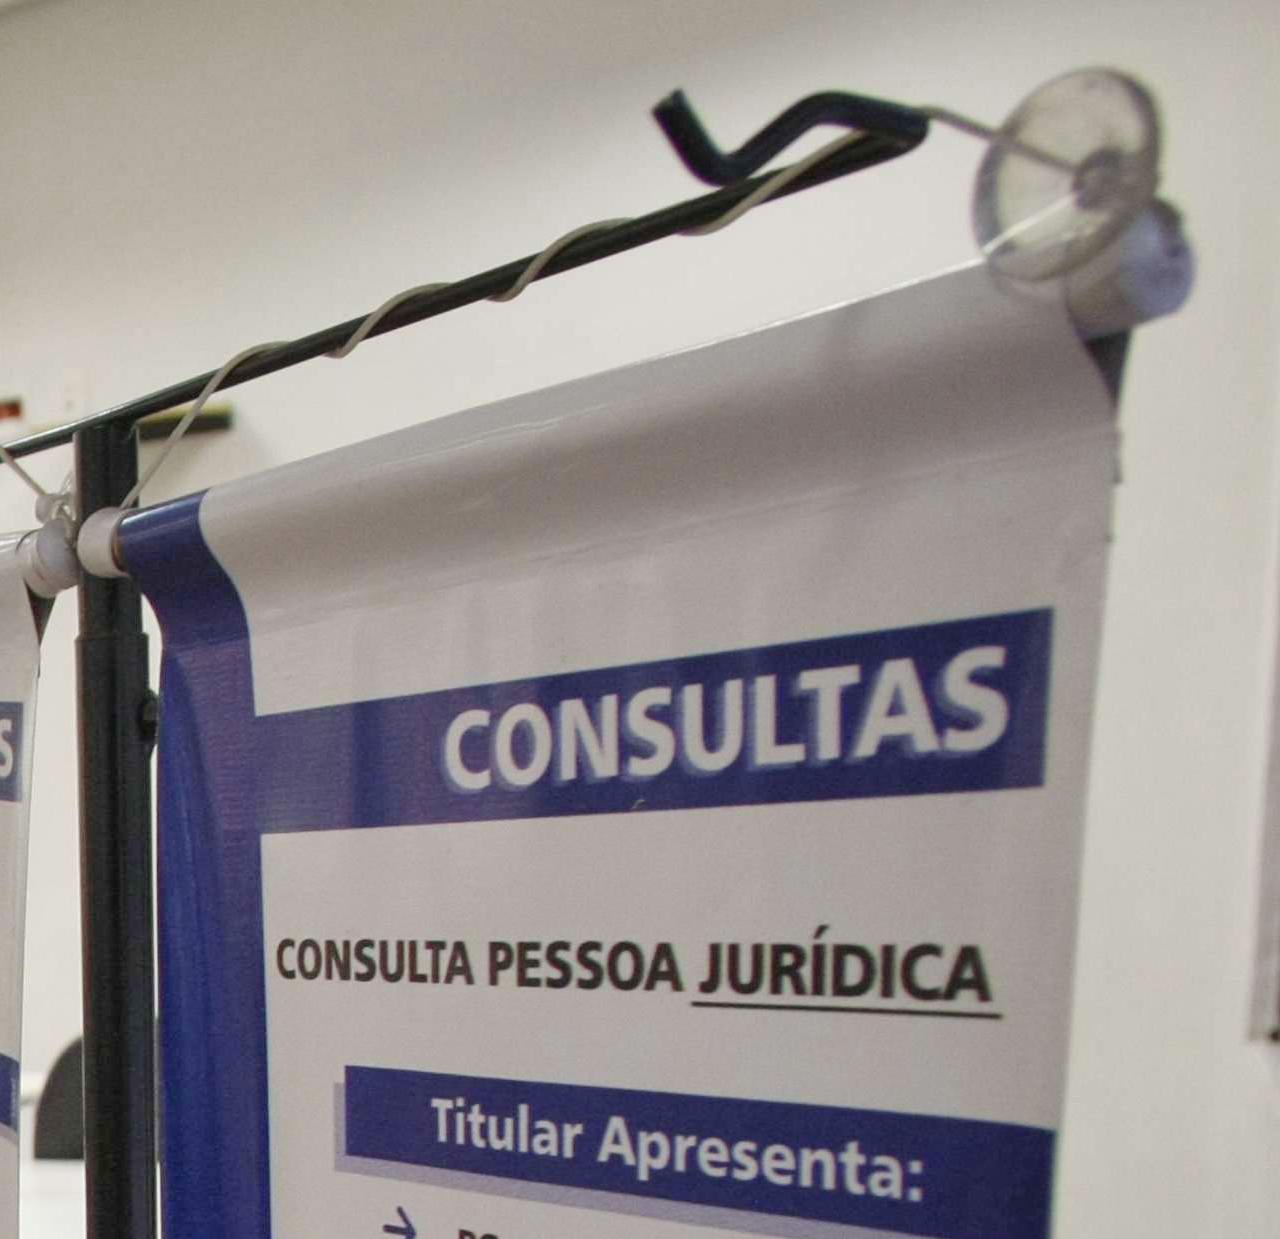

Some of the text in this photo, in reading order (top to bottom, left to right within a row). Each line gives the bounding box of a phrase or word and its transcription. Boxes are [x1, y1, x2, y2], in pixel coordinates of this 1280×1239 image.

[445, 645, 1010, 791] CONSULTAS
[276, 925, 991, 1002] CONSULTA PESSOA JURÍDICA
[432, 1099, 923, 1202] Titular Apresenta:
